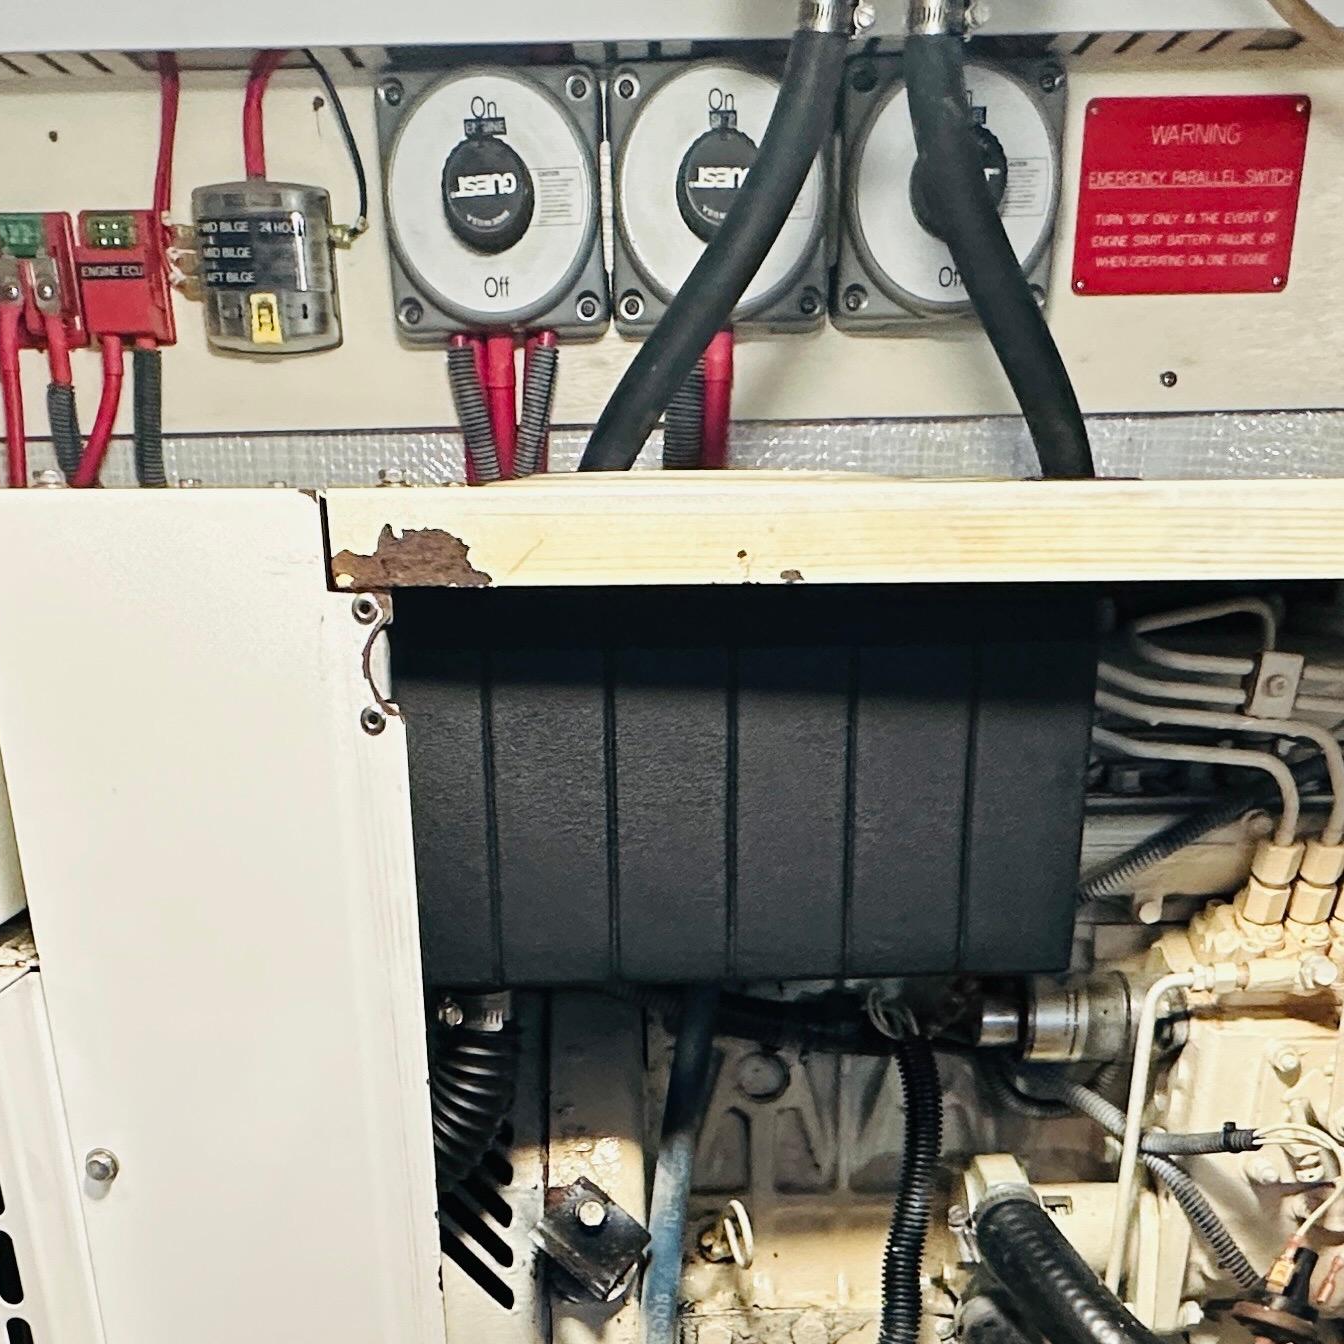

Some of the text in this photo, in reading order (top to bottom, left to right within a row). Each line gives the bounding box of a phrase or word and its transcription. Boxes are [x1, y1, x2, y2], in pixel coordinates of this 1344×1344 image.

[471, 96, 498, 118] On
[709, 88, 734, 110] On
[1151, 123, 1241, 145] WARNING
[454, 172, 517, 199] GUEST
[1088, 168, 1294, 187] EMERGENCY PARALLEL SWITCH
[1095, 214, 1123, 225] TURN
[1153, 213, 1179, 225] ONLY
[1200, 212, 1220, 224] THE
[1224, 211, 1260, 224] EVENT
[1263, 210, 1279, 222] OF
[1091, 235, 1129, 247] ENGINE
[1133, 235, 1163, 247] START
[1167, 234, 1212, 246] BATTERY
[1217, 233, 1256, 245] FAILURE
[221, 247, 252, 258] BILGE
[1095, 255, 1126, 267] WHEN
[1130, 255, 1185, 267] OPERATING
[1207, 254, 1228, 266] ONE
[1232, 253, 1269, 265] ENGINE
[81, 265, 143, 277] ENGINE ECU
[226, 271, 255, 282] BILGE
[484, 277, 510, 298] Off
